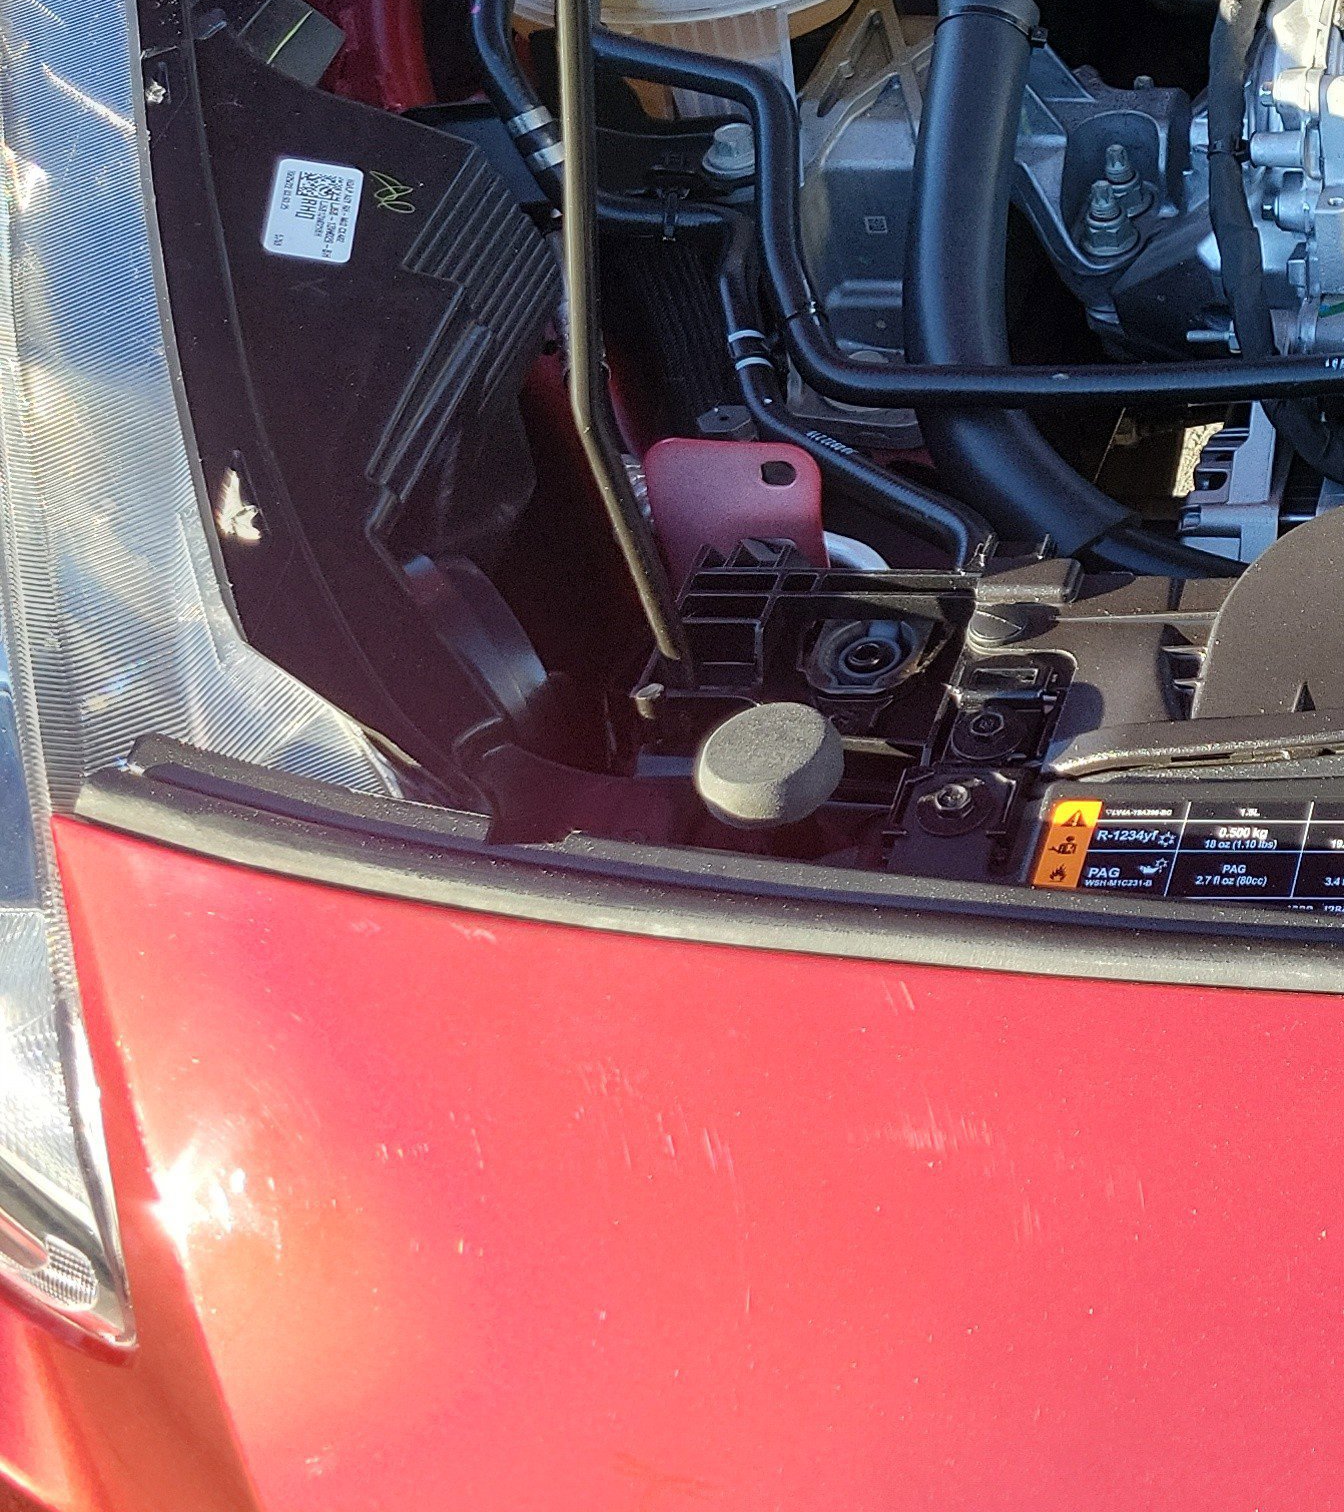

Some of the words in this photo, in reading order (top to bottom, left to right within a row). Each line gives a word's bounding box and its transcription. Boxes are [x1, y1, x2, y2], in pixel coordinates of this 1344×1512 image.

[1097, 829, 1159, 842] R-1234yf
[1219, 827, 1251, 838] 0.500
[1253, 827, 1268, 840] kg
[1204, 840, 1215, 849] 18
[1216, 841, 1231, 849] oz
[1087, 867, 1121, 878] PAG
[1222, 864, 1247, 874] PAG
[1195, 876, 1210, 885] 2.7
[1236, 876, 1267, 886] (80cc)
[1324, 877, 1340, 886] 3.4
